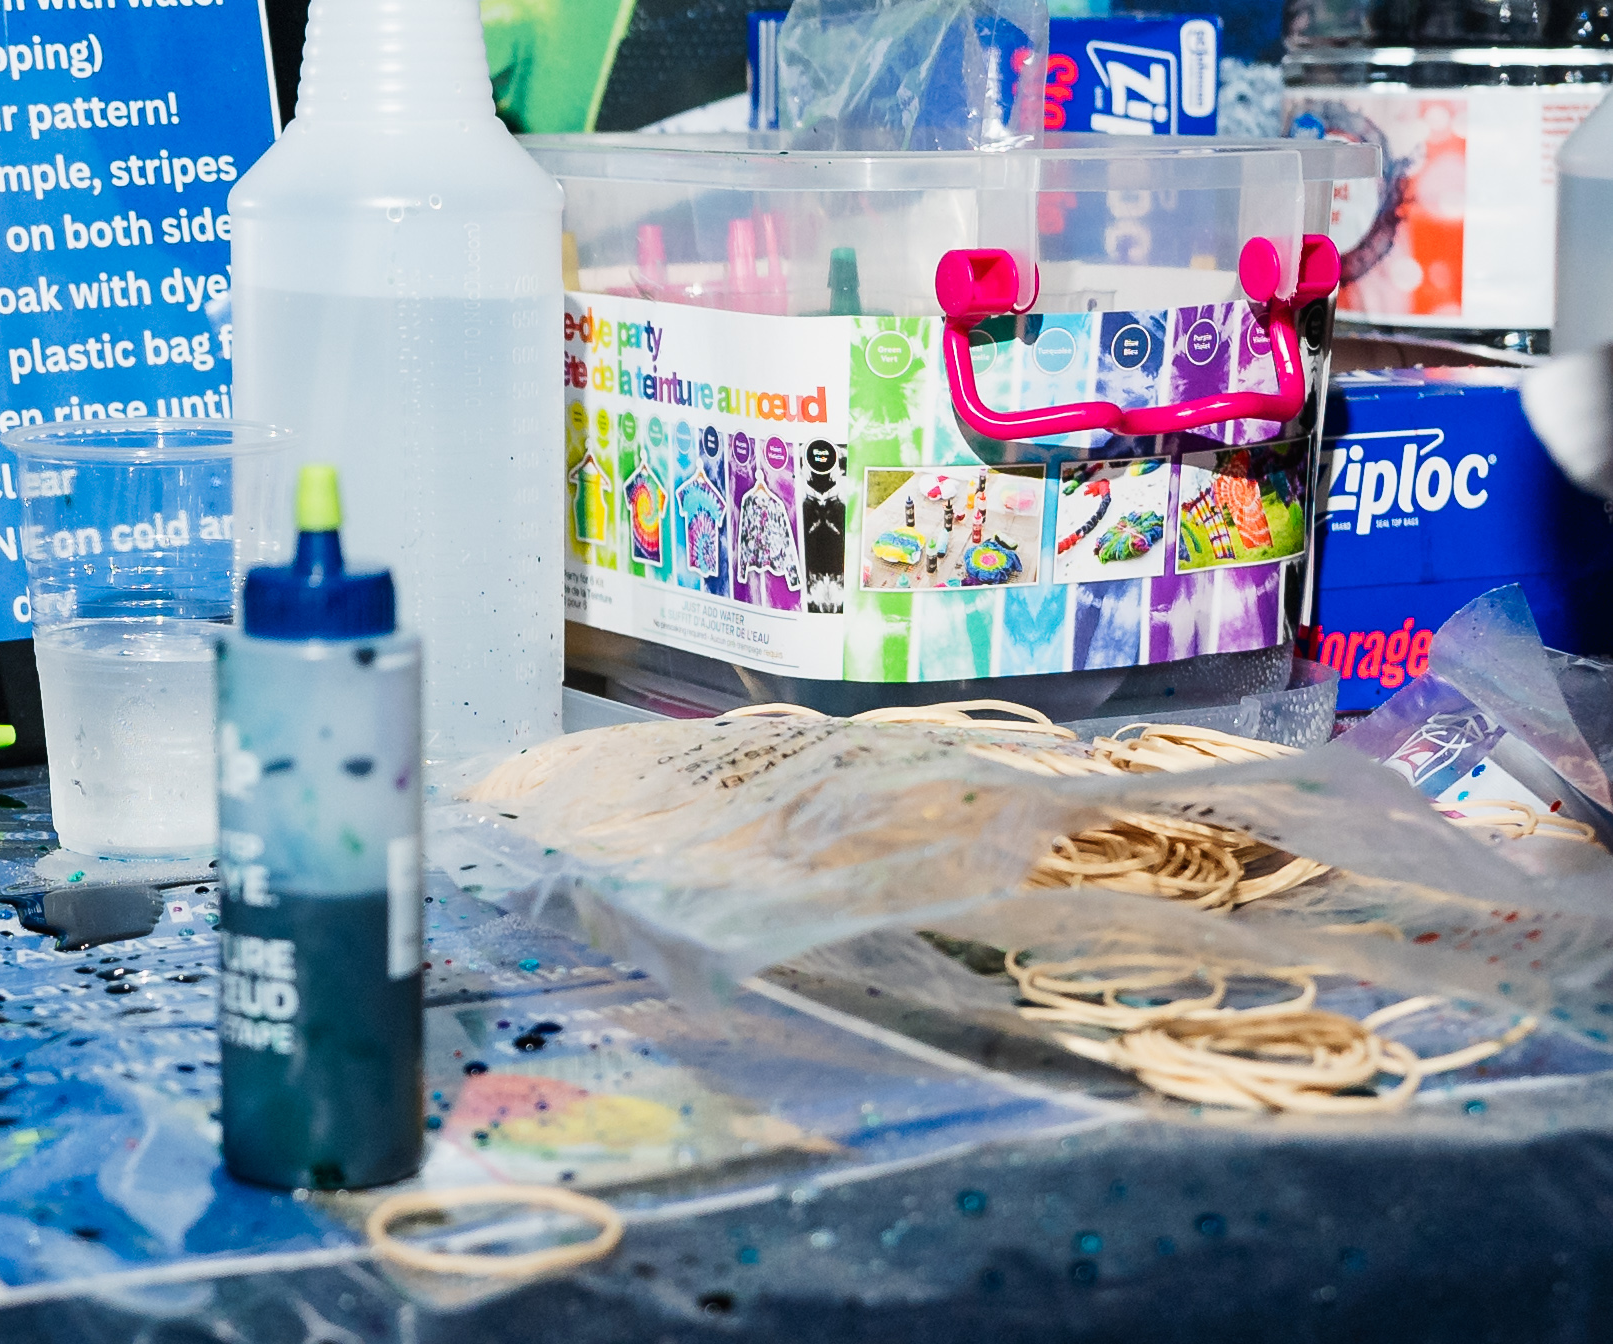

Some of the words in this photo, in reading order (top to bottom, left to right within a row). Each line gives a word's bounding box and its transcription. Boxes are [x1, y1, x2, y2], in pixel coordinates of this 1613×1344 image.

[28, 92, 179, 139] pattern!
[110, 150, 237, 192] stripes
[6, 224, 54, 252] on
[64, 211, 153, 249] both
[162, 207, 232, 243] side
[69, 271, 151, 309] with
[161, 267, 233, 311] dye
[9, 333, 136, 384] plastic
[144, 330, 214, 371] bag
[564, 307, 612, 354] e-dye
[618, 320, 663, 362] party
[877, 345, 902, 354] Green
[1037, 346, 1073, 356] Turquoise
[54, 396, 148, 435] rinse
[156, 384, 233, 420] unti
[592, 358, 614, 393] de
[618, 359, 633, 397] la
[635, 364, 714, 410] teinture
[717, 385, 741, 415] au
[745, 386, 828, 423] nœud
[1325, 443, 1490, 535] Ziploc
[52, 527, 103, 558] on
[111, 510, 189, 552] cold
[200, 514, 233, 541] an
[702, 605, 718, 618] ADD
[720, 608, 745, 626] WATER
[735, 626, 746, 639] DE
[1314, 617, 1434, 687] torage
